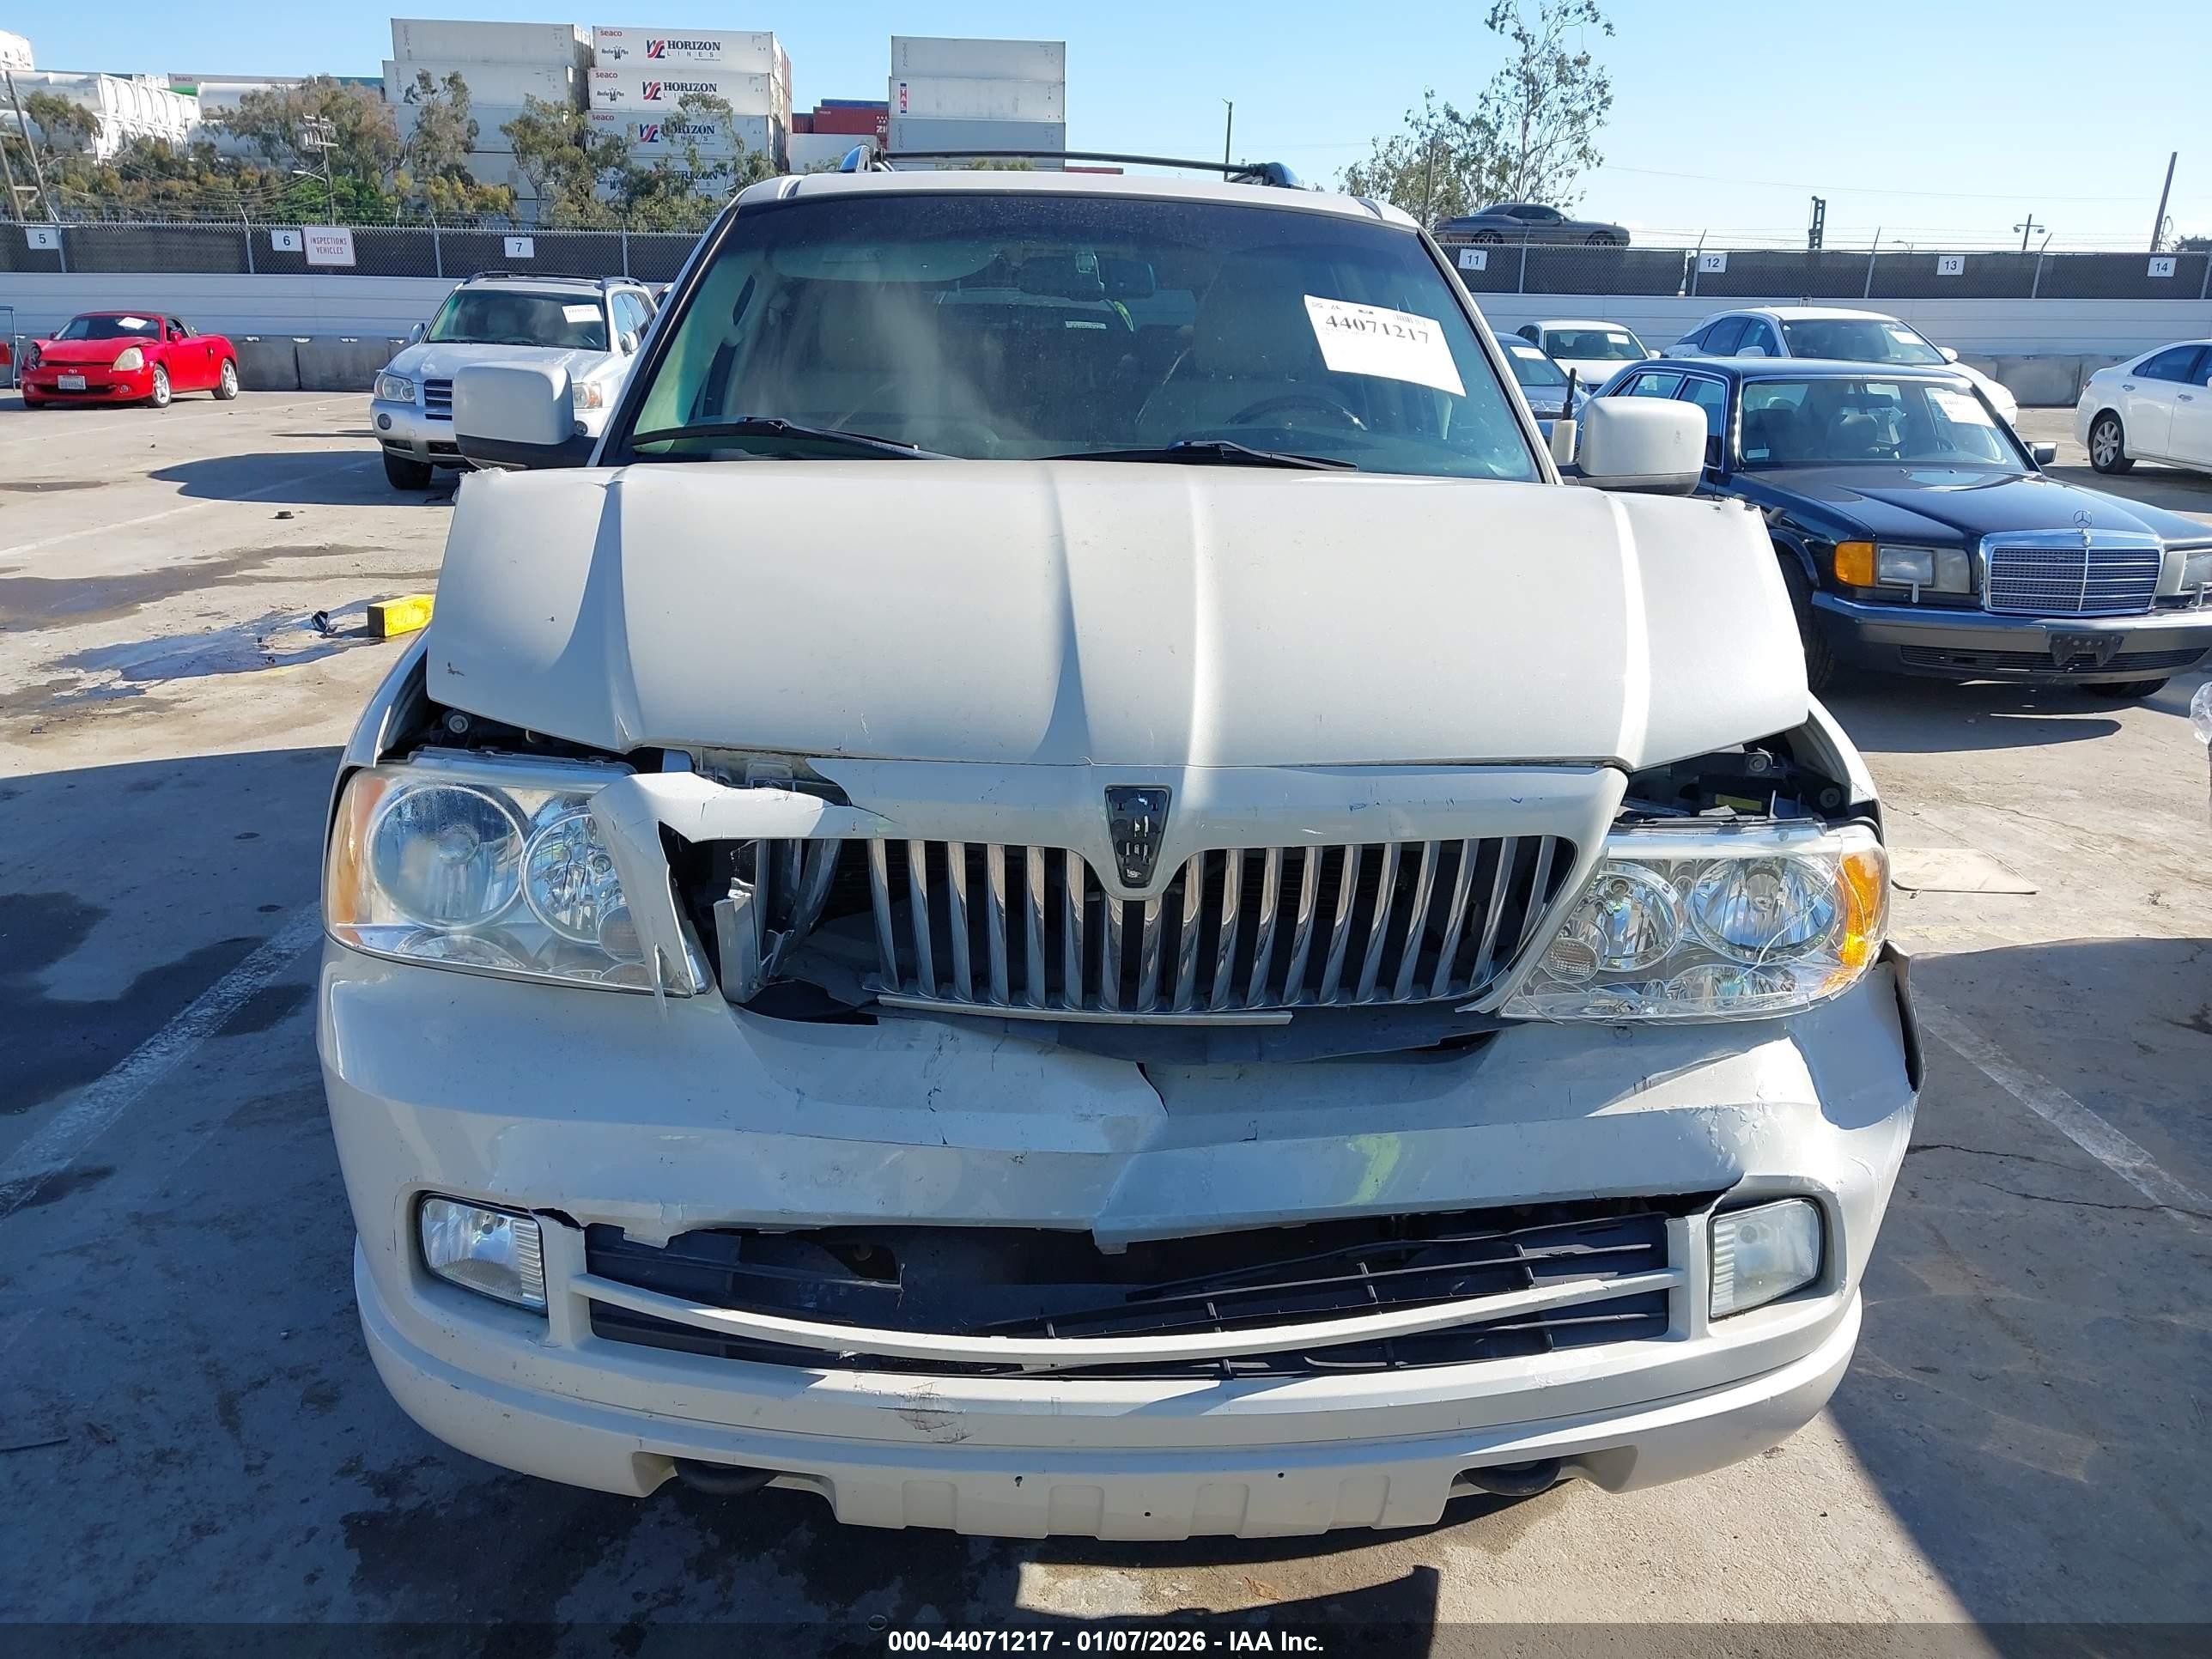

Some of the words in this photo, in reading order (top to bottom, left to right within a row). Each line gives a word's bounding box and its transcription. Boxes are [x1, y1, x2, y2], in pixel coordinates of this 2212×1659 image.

[666, 40, 721, 52] HORIZON
[663, 82, 718, 93] HORIZON
[38, 233, 46, 244] 5
[283, 235, 291, 246] 6
[310, 236, 348, 246] INSPECTIONS
[315, 246, 344, 255] VEHICLES
[515, 241, 523, 253] 7
[1467, 254, 1480, 265] 11
[1705, 258, 1720, 268] 12
[1945, 260, 1958, 270] 13
[2155, 262, 2169, 272] 14
[1325, 314, 1429, 344] 44071217
